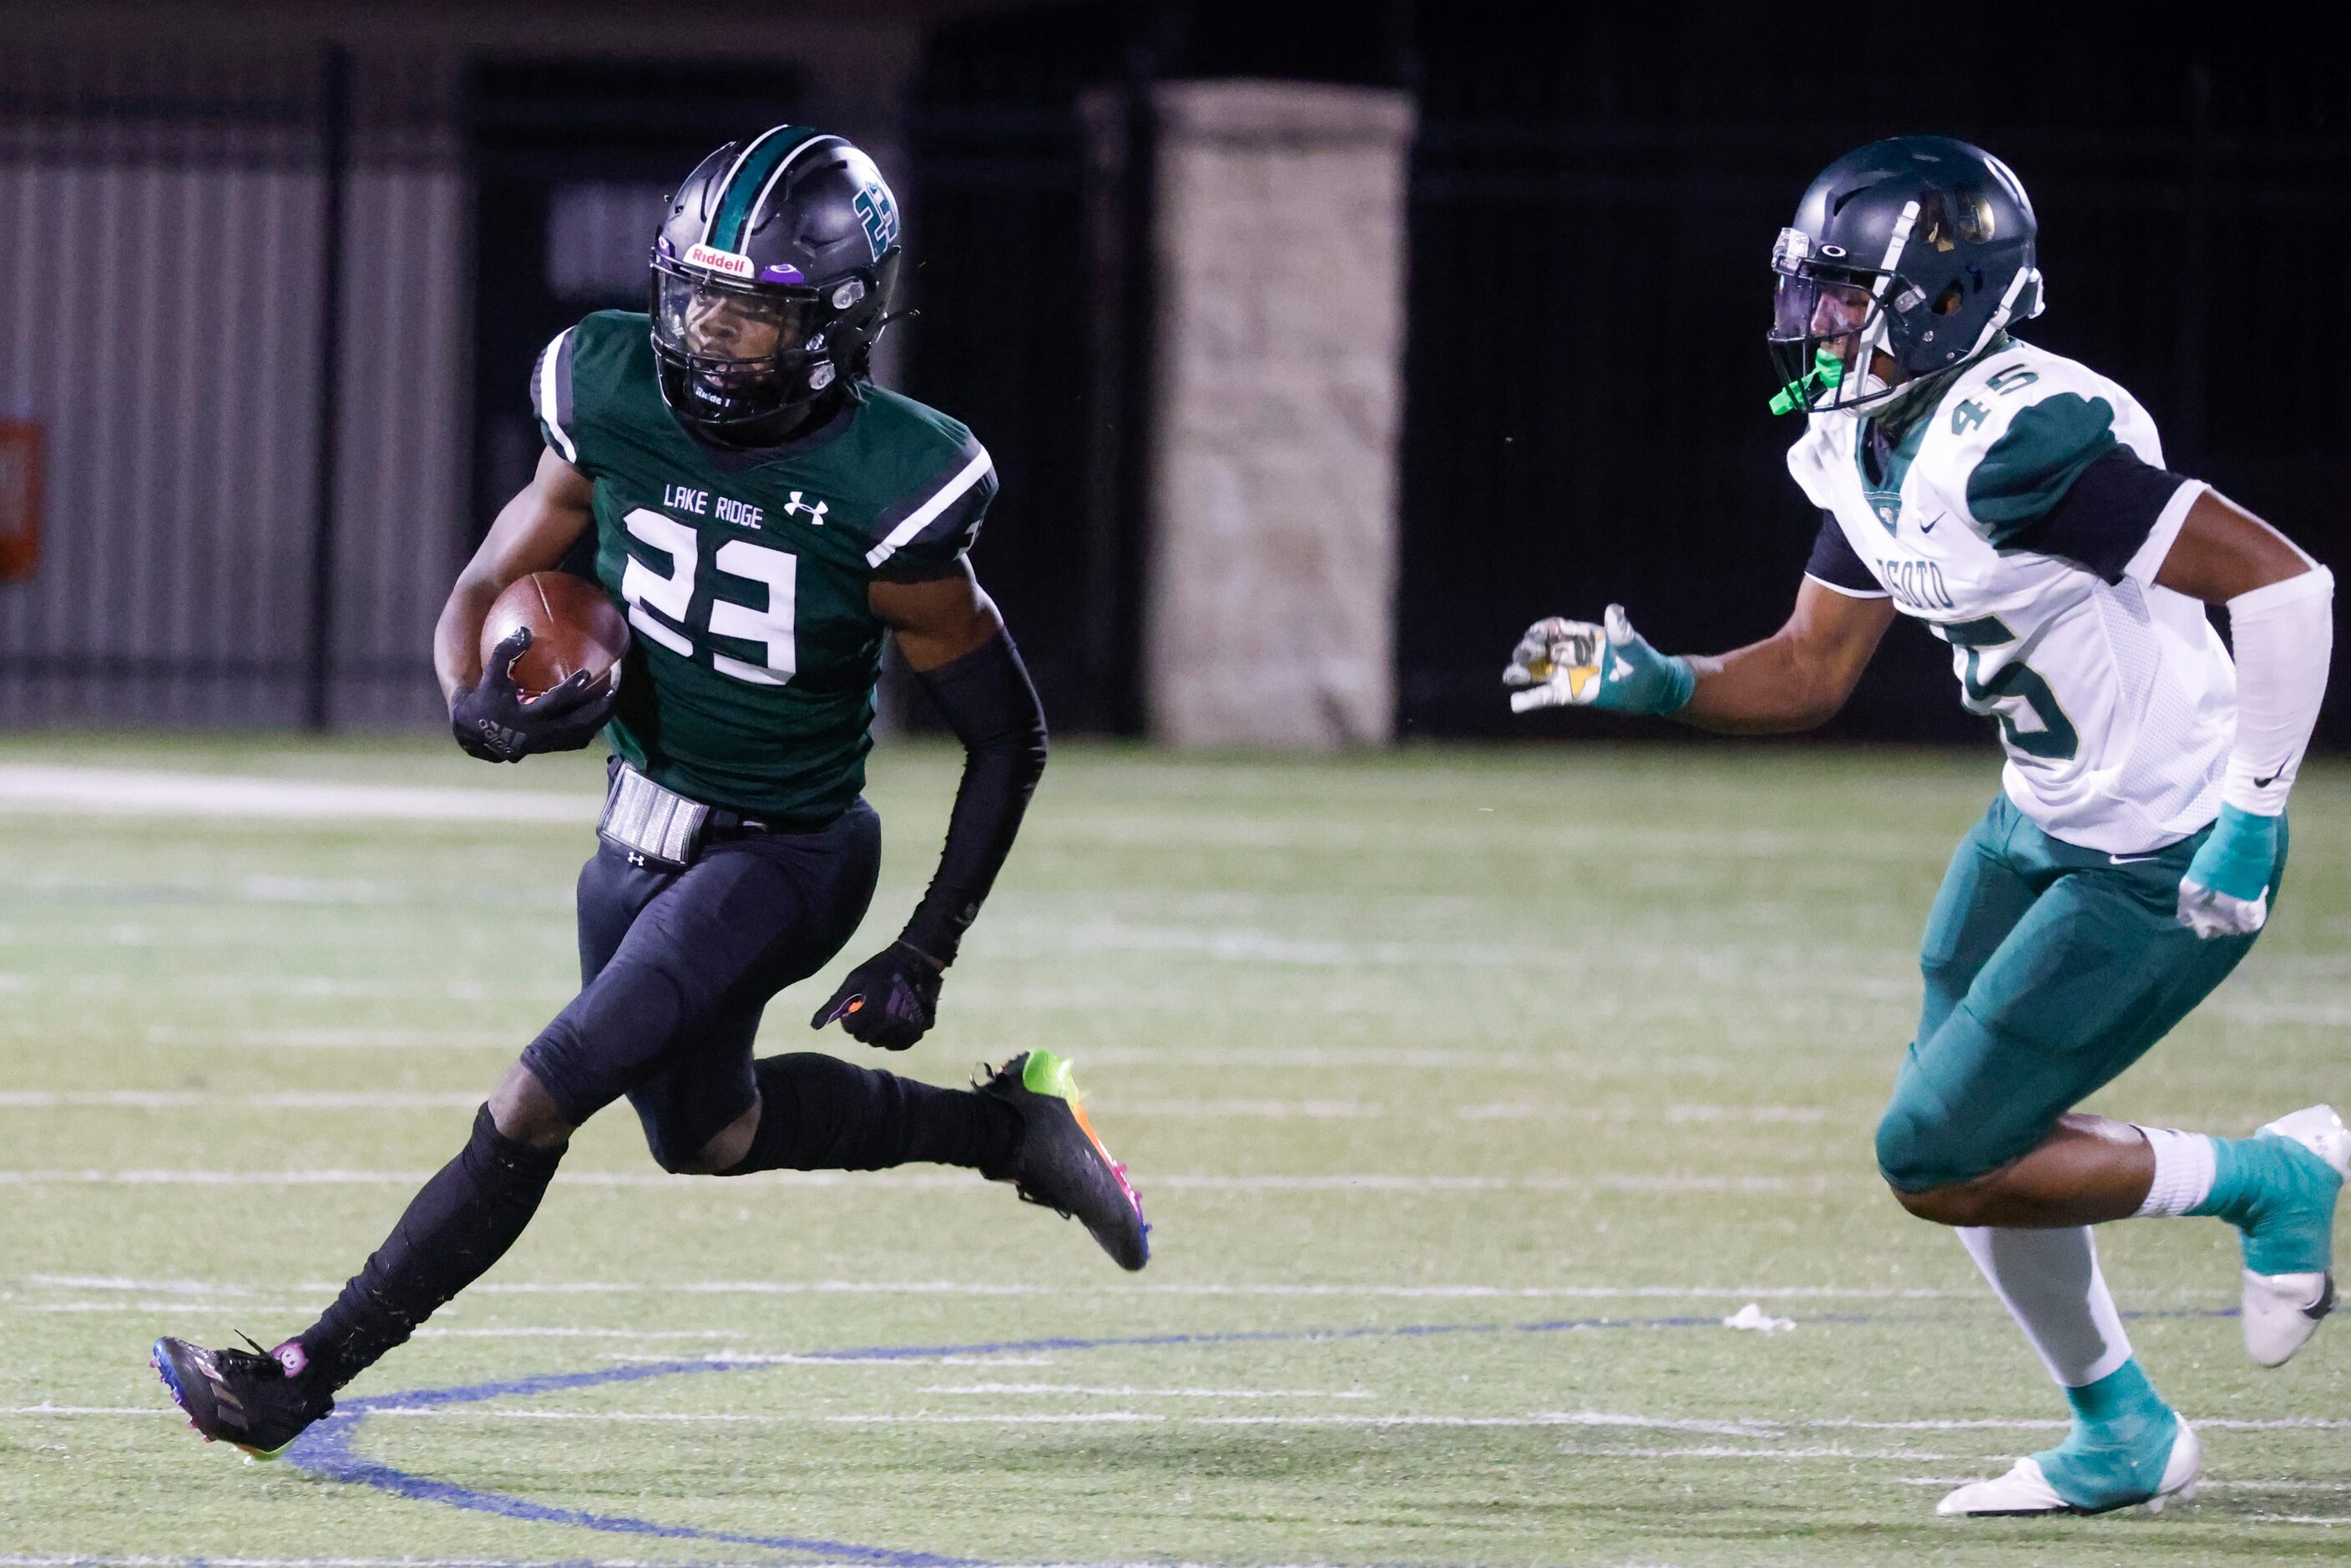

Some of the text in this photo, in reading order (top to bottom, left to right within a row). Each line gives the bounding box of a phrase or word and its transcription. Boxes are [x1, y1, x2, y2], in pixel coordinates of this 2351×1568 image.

[692, 248, 745, 272] Riddell
[695, 386, 731, 407] Riddel
[1951, 363, 2040, 437] 45
[664, 483, 764, 530] LAKE RIDGE
[621, 507, 797, 686] 23
